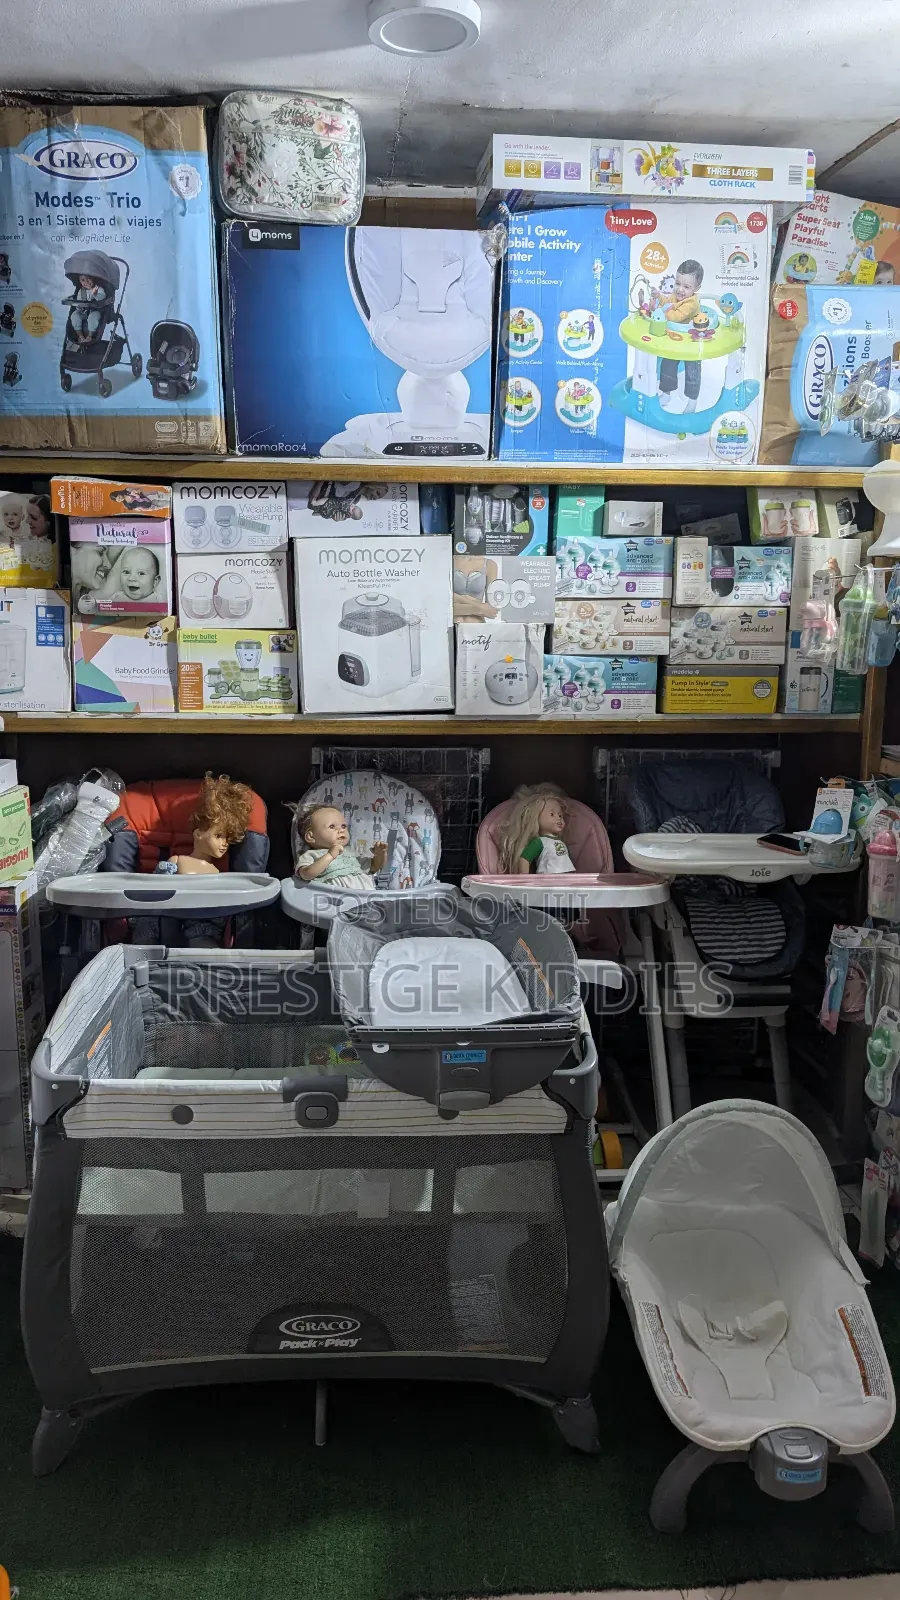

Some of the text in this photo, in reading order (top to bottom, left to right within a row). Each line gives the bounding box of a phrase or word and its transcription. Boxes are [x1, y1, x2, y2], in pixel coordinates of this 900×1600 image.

[48, 148, 127, 169] GRACO
[706, 166, 759, 178] THREE LAYERS
[709, 180, 733, 188] CLOTH
[106, 191, 142, 209] Trio
[17, 215, 25, 227] 3
[28, 217, 43, 226] en
[46, 214, 52, 226] 1
[56, 214, 106, 226] Sistema
[126, 216, 162, 229] viajes
[609, 215, 653, 227] Tiny Love
[534, 226, 568, 236] Grow
[794, 222, 826, 236] Playful
[50, 234, 66, 244] con
[114, 233, 131, 243] Lite
[791, 233, 829, 248] Paradise
[538, 239, 582, 253] Activity
[645, 248, 667, 262] 28+
[524, 268, 547, 277] Journey
[537, 278, 563, 286] Discovery
[808, 343, 827, 408] GRACO
[262, 513, 284, 522] Pump
[96, 523, 138, 539] Natural
[326, 568, 421, 578] Auto Bottle Washer
[623, 615, 644, 623] natural
[739, 625, 760, 633] natural
[182, 633, 199, 641] baby
[461, 633, 492, 651] motif
[114, 667, 131, 676] Baby
[150, 667, 176, 675] Grinder
[181, 664, 190, 672] 20
[3, 700, 46, 709] sterilisation
[749, 867, 772, 877] Joie
[291, 1320, 353, 1332] GRACO
[278, 1338, 360, 1350] Pack Play
